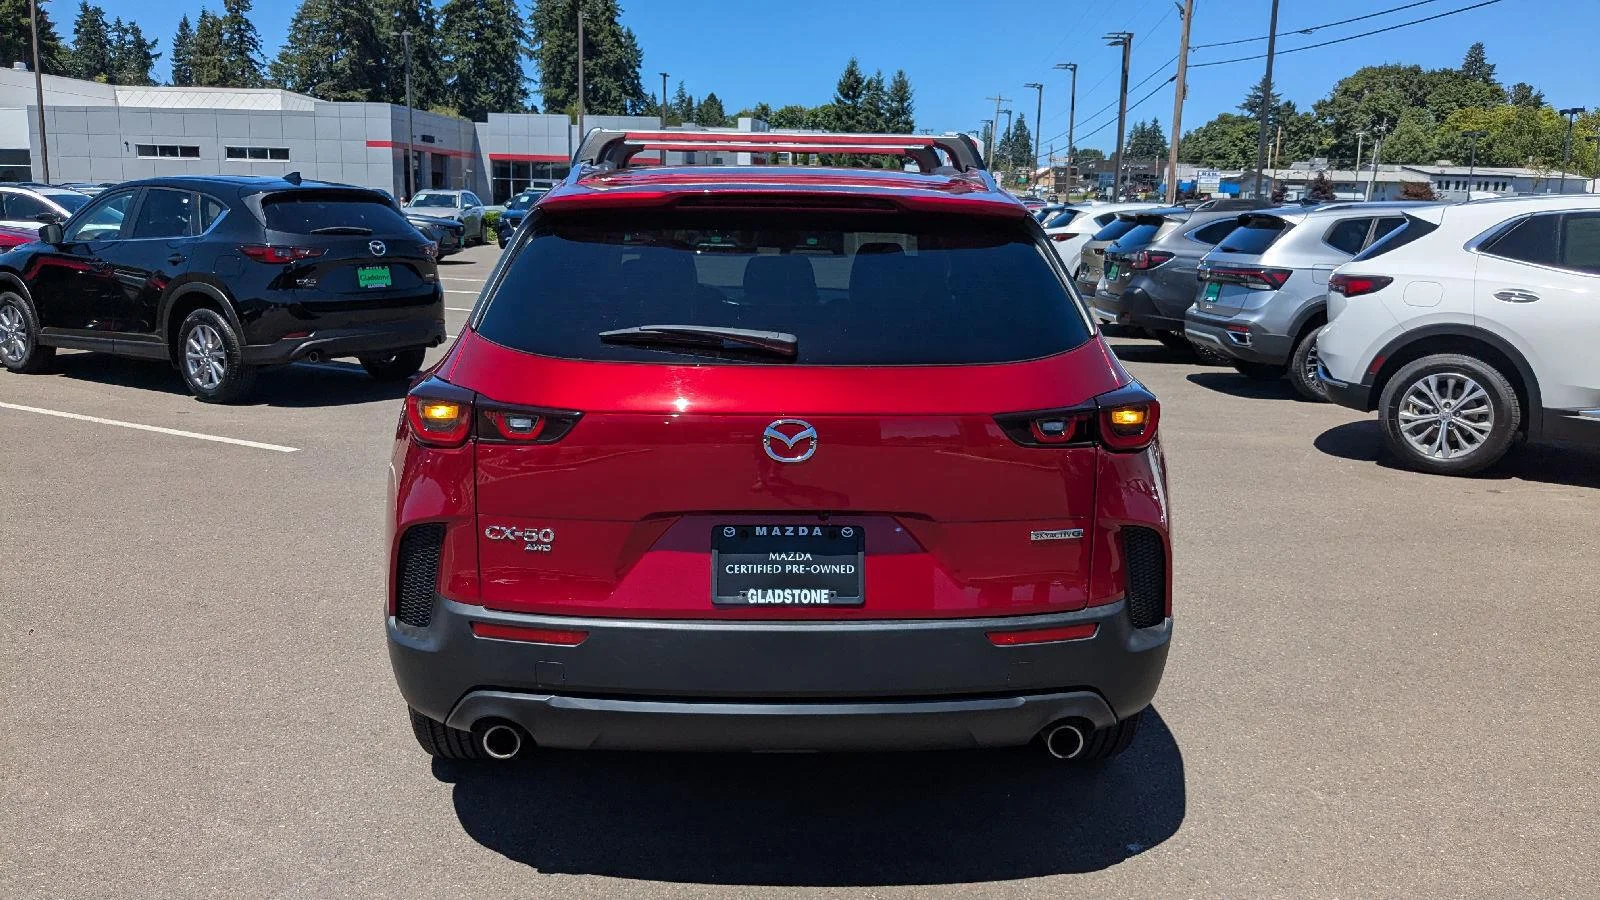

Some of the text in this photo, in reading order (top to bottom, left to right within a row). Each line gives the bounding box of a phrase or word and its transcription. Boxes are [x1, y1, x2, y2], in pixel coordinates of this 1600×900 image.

[485, 525, 555, 542] CX-50
[756, 526, 822, 536] MAZDA
[524, 543, 552, 551] AWD
[768, 551, 812, 561] MAZDA
[725, 564, 855, 574] CERTIFIED PRE-OWNED
[747, 588, 830, 604] GLADSTONE
